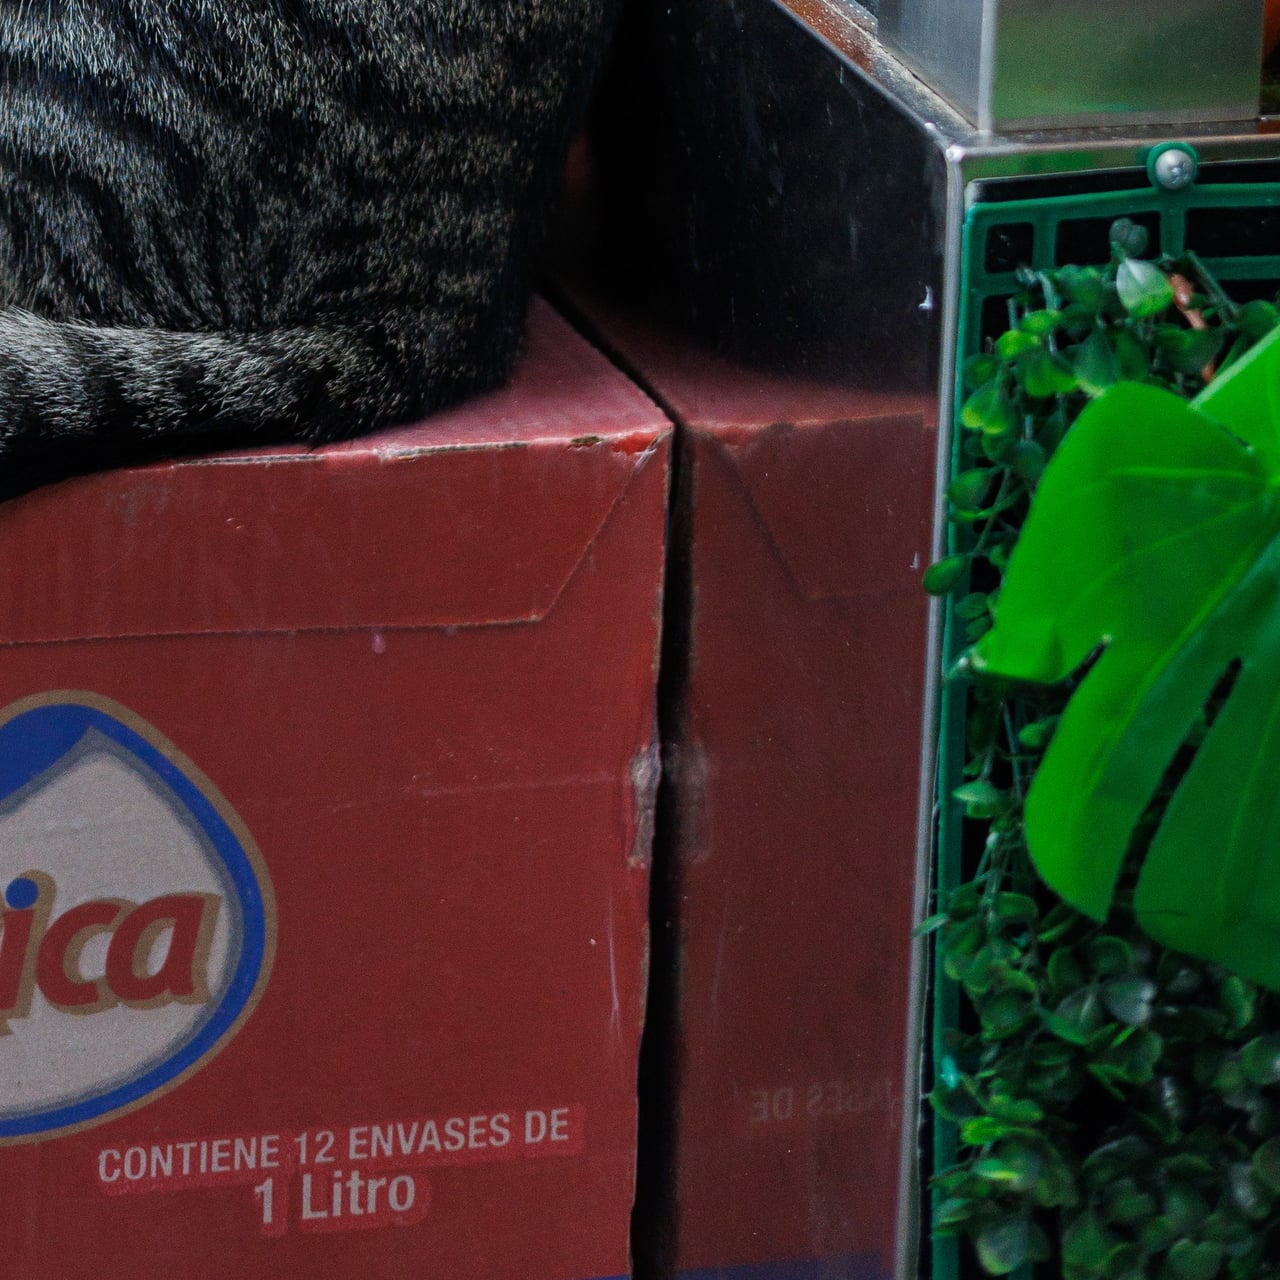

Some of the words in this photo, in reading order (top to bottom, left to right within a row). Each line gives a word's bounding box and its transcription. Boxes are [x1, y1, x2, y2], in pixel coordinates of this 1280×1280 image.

[97, 1134, 280, 1183] CONTIENE
[294, 1130, 335, 1165] 12
[348, 1112, 511, 1161] ENVASES
[524, 1107, 570, 1144] DE
[254, 1176, 274, 1225] 1
[301, 1168, 416, 1221] Litro
